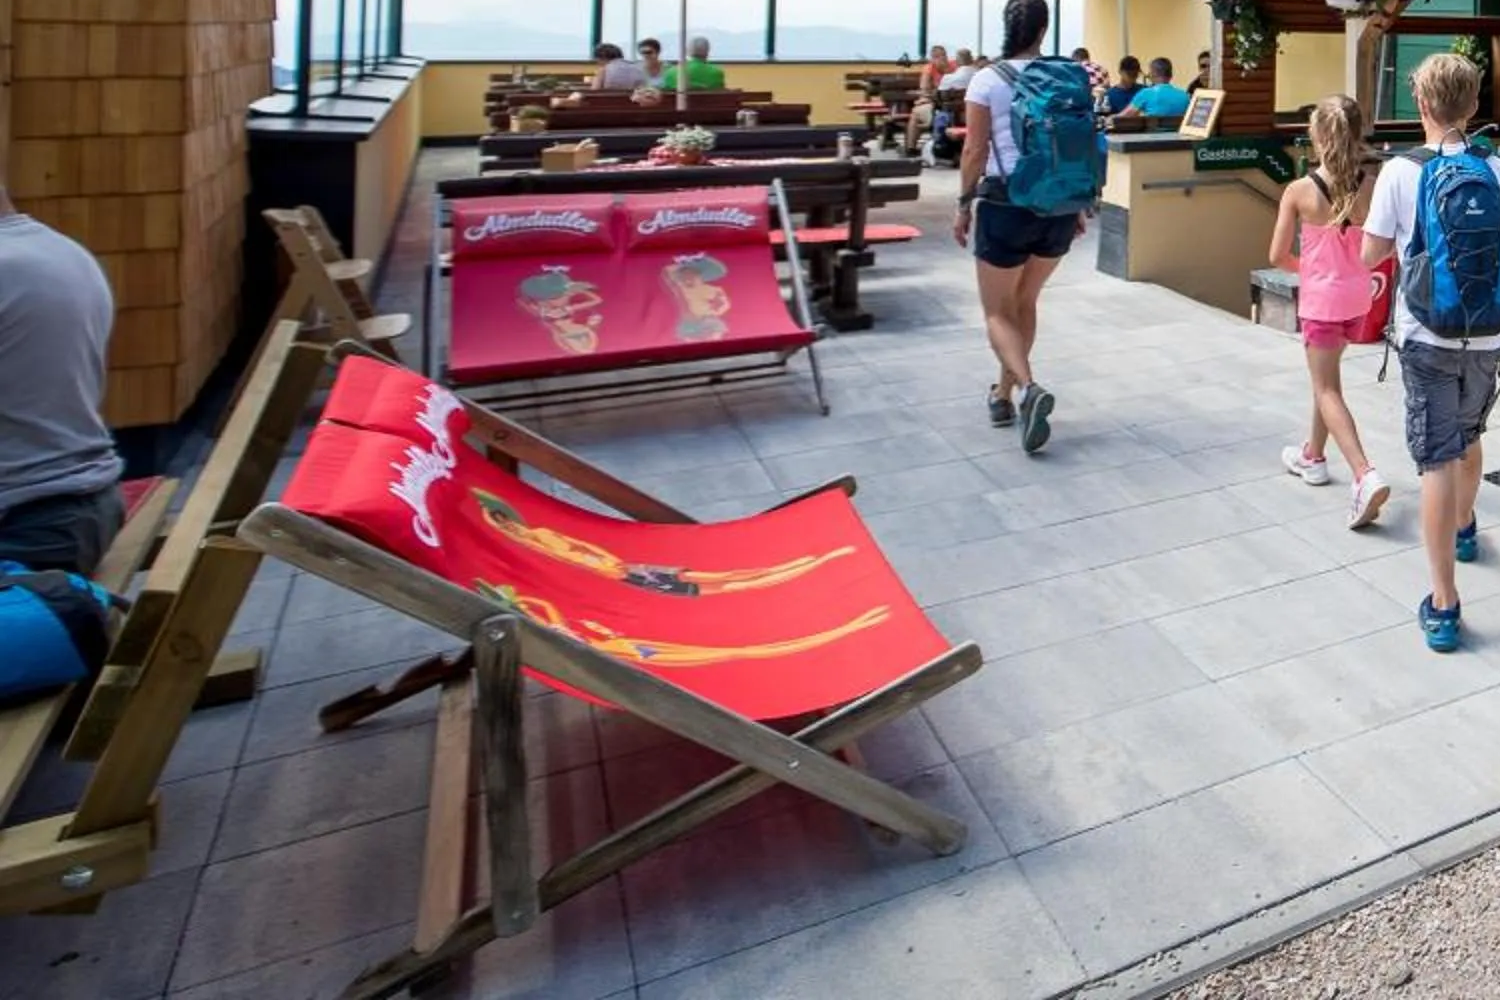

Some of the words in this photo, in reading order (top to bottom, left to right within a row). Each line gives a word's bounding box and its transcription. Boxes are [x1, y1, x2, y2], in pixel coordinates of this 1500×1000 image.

[1197, 146, 1260, 162] Gaststube
[464, 210, 598, 241] Almdudler
[637, 207, 757, 235] Almdudler
